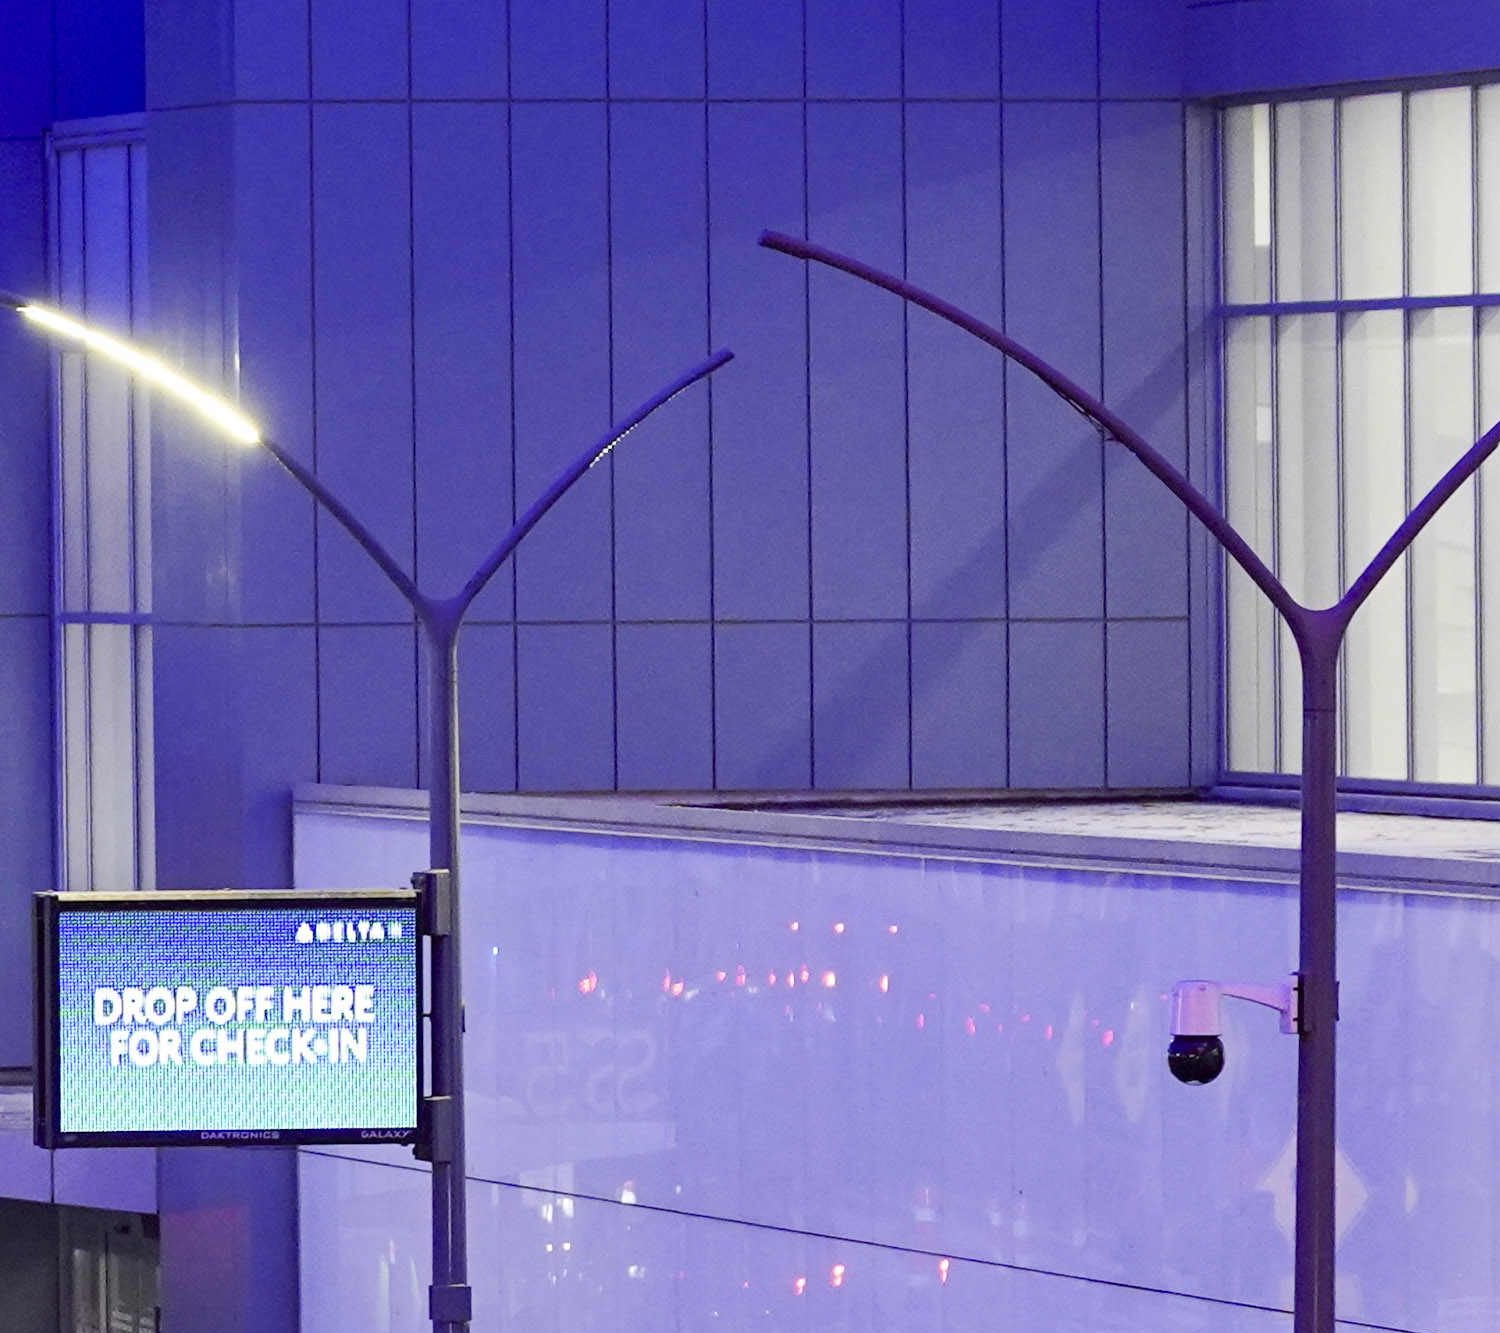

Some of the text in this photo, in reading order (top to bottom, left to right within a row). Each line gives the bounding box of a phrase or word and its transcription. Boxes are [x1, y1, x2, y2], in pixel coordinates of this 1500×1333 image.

[315, 923, 385, 943] DELTA
[94, 983, 376, 1026] DROP OFF HERE
[110, 1029, 182, 1065] FOR
[200, 1129, 411, 1140] DAKTRONICS GALAXY
